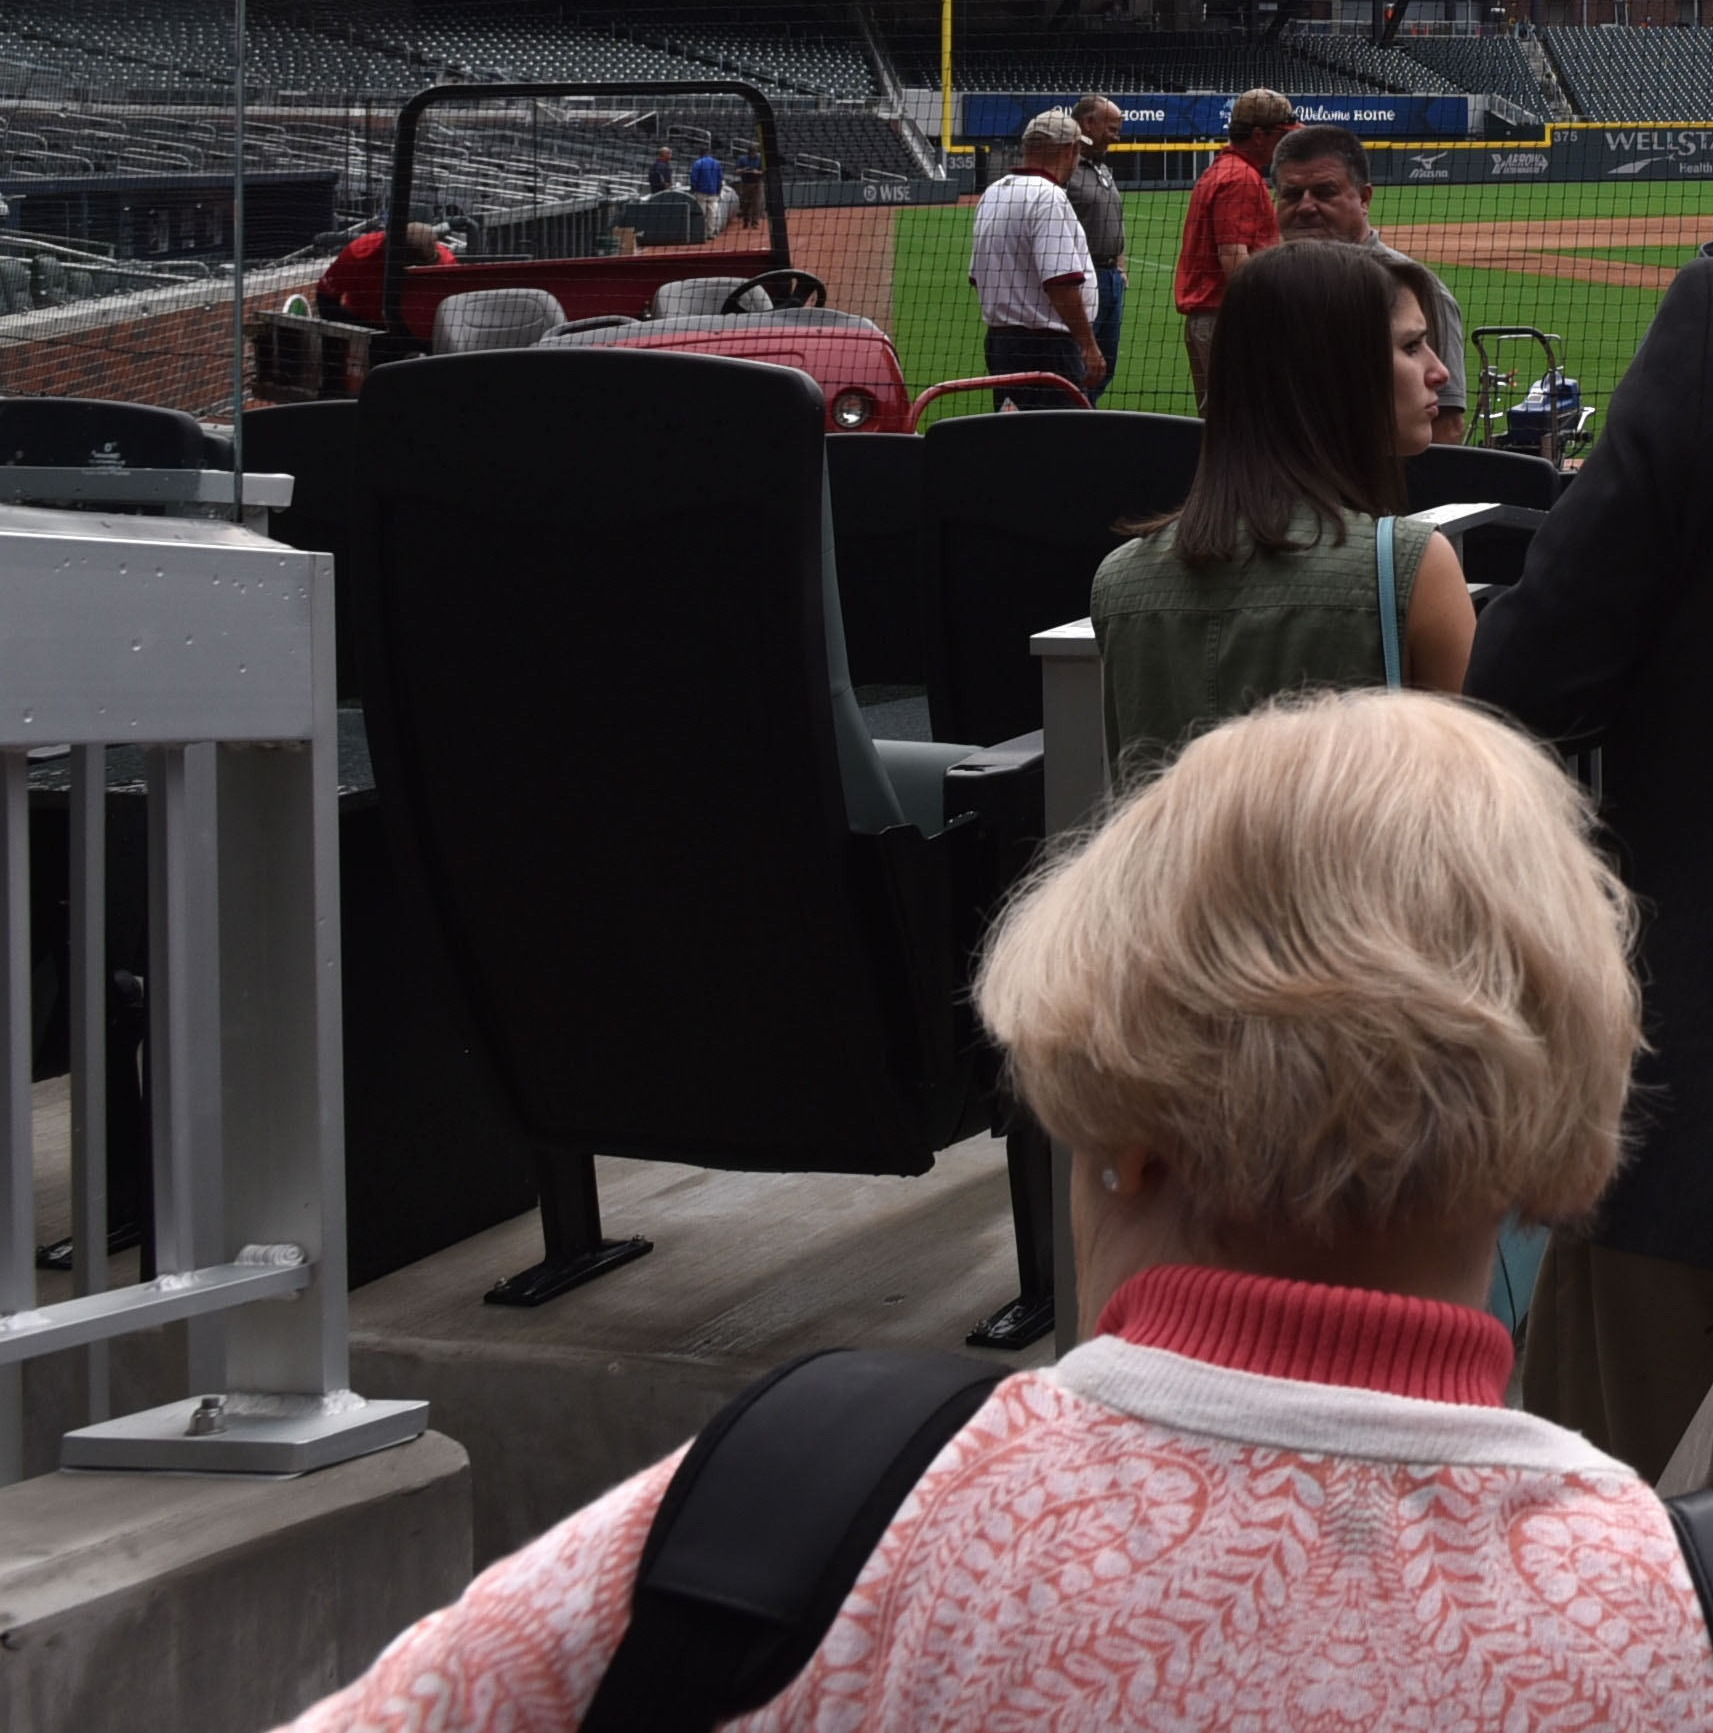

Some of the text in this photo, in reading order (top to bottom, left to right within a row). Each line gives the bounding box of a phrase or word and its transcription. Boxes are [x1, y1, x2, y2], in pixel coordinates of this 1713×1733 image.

[1553, 130, 1579, 143] 375
[948, 156, 974, 169] 335
[1679, 161, 1713, 174] Health
[1409, 168, 1448, 179] Mizuno
[880, 184, 912, 201] WISE
